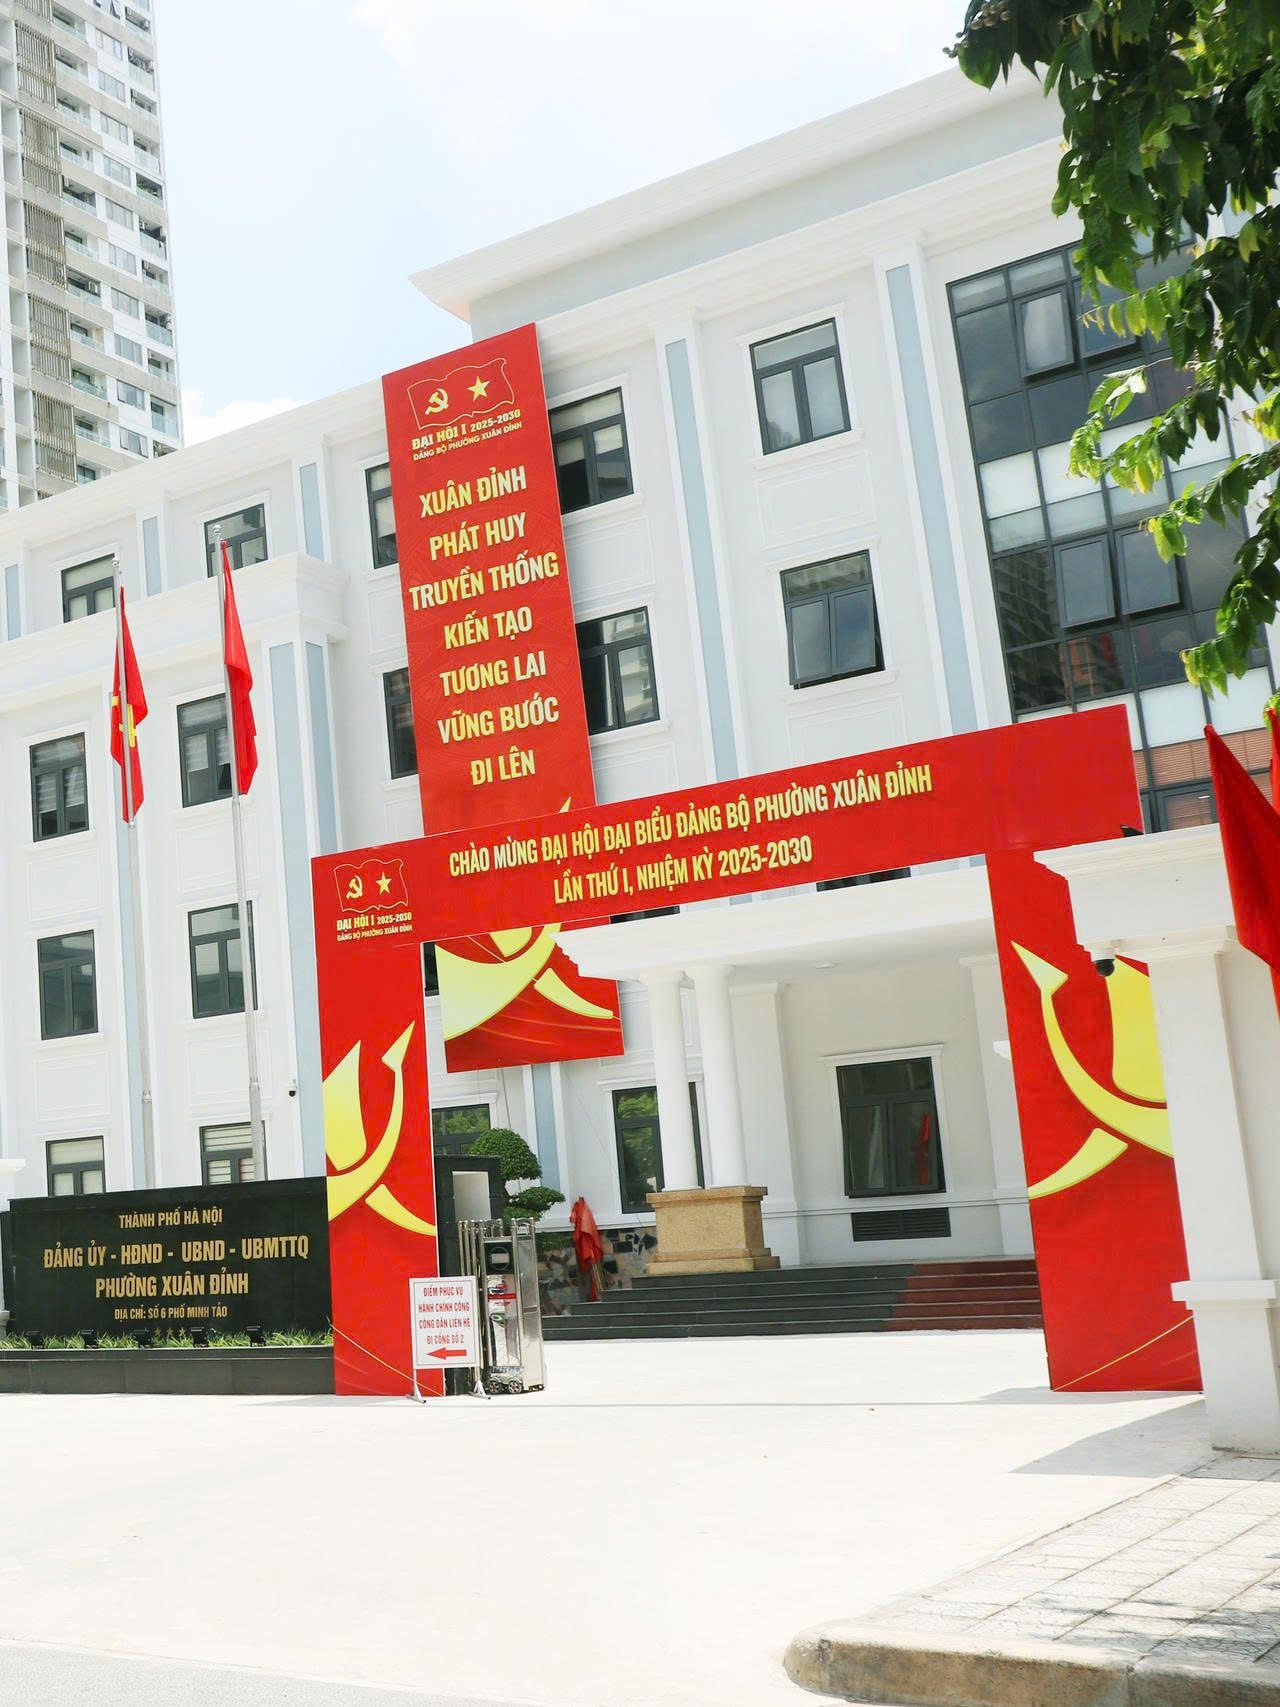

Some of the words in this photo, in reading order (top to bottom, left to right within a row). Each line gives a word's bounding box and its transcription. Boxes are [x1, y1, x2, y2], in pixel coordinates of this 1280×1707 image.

[412, 434, 433, 450] ĐẠI
[436, 426, 458, 442] HỘI
[461, 424, 466, 435] I
[470, 409, 521, 433] 2025-2030
[482, 428, 501, 440] XUÂN
[419, 480, 472, 517] XUÂN
[477, 466, 526, 502] ĐỈNH
[430, 521, 479, 560] PHÁT
[485, 512, 525, 546] HUY
[409, 566, 484, 610] TRUYỀN
[488, 550, 559, 591] THỐNG
[444, 610, 489, 649] KIẾN
[493, 607, 532, 640] TẠO
[440, 660, 508, 696] TƯƠNG
[514, 651, 546, 680] LAI
[438, 710, 494, 743] VỮNG
[500, 692, 559, 731] BƯỚC
[471, 758, 493, 785] ĐI
[498, 746, 535, 780] LÊN
[450, 842, 489, 876] CHÀO
[494, 836, 538, 869] MỪNG
[542, 834, 567, 864] ĐẠI
[572, 828, 599, 859] HỘI
[604, 823, 630, 854] ĐẠI
[635, 806, 672, 845] BIỂU
[676, 803, 722, 837] ĐẢNG
[726, 800, 750, 831] BỘ
[754, 783, 828, 823] PHƯỜNG
[832, 770, 881, 808] XUÂN
[885, 761, 932, 798] ĐỈNH
[554, 869, 583, 903] LẦN
[586, 863, 618, 898] THỨ
[623, 868, 633, 895] I,
[637, 854, 688, 891] NHIỆM
[692, 847, 713, 881] KỲ
[718, 835, 812, 876] 2025-2030
[337, 919, 352, 931] ĐẠI
[354, 914, 369, 929] HỘI
[377, 912, 411, 924] 2025-2030
[119, 1212, 154, 1228] THÀNH
[158, 1207, 180, 1225] PHỐ
[184, 1208, 199, 1224] HÀ
[203, 1207, 222, 1225] NỘI
[44, 1243, 83, 1268] ĐẢNG
[88, 1240, 106, 1266] ỦY
[121, 1243, 162, 1264] HĐND
[182, 1240, 225, 1262] UBND
[242, 1235, 308, 1259] UBMTTQ
[96, 1273, 157, 1297] PHƯỜNG
[162, 1271, 204, 1296] XUÂN
[209, 1267, 248, 1294] ĐỈNH
[115, 1309, 128, 1322] ĐỊA
[130, 1306, 145, 1319] CHỈ:
[148, 1306, 158, 1319] SỐ
[161, 1308, 166, 1318] 6
[168, 1305, 185, 1318] PHỐ
[187, 1307, 209, 1318] MINH
[212, 1304, 227, 1317] TẢO
